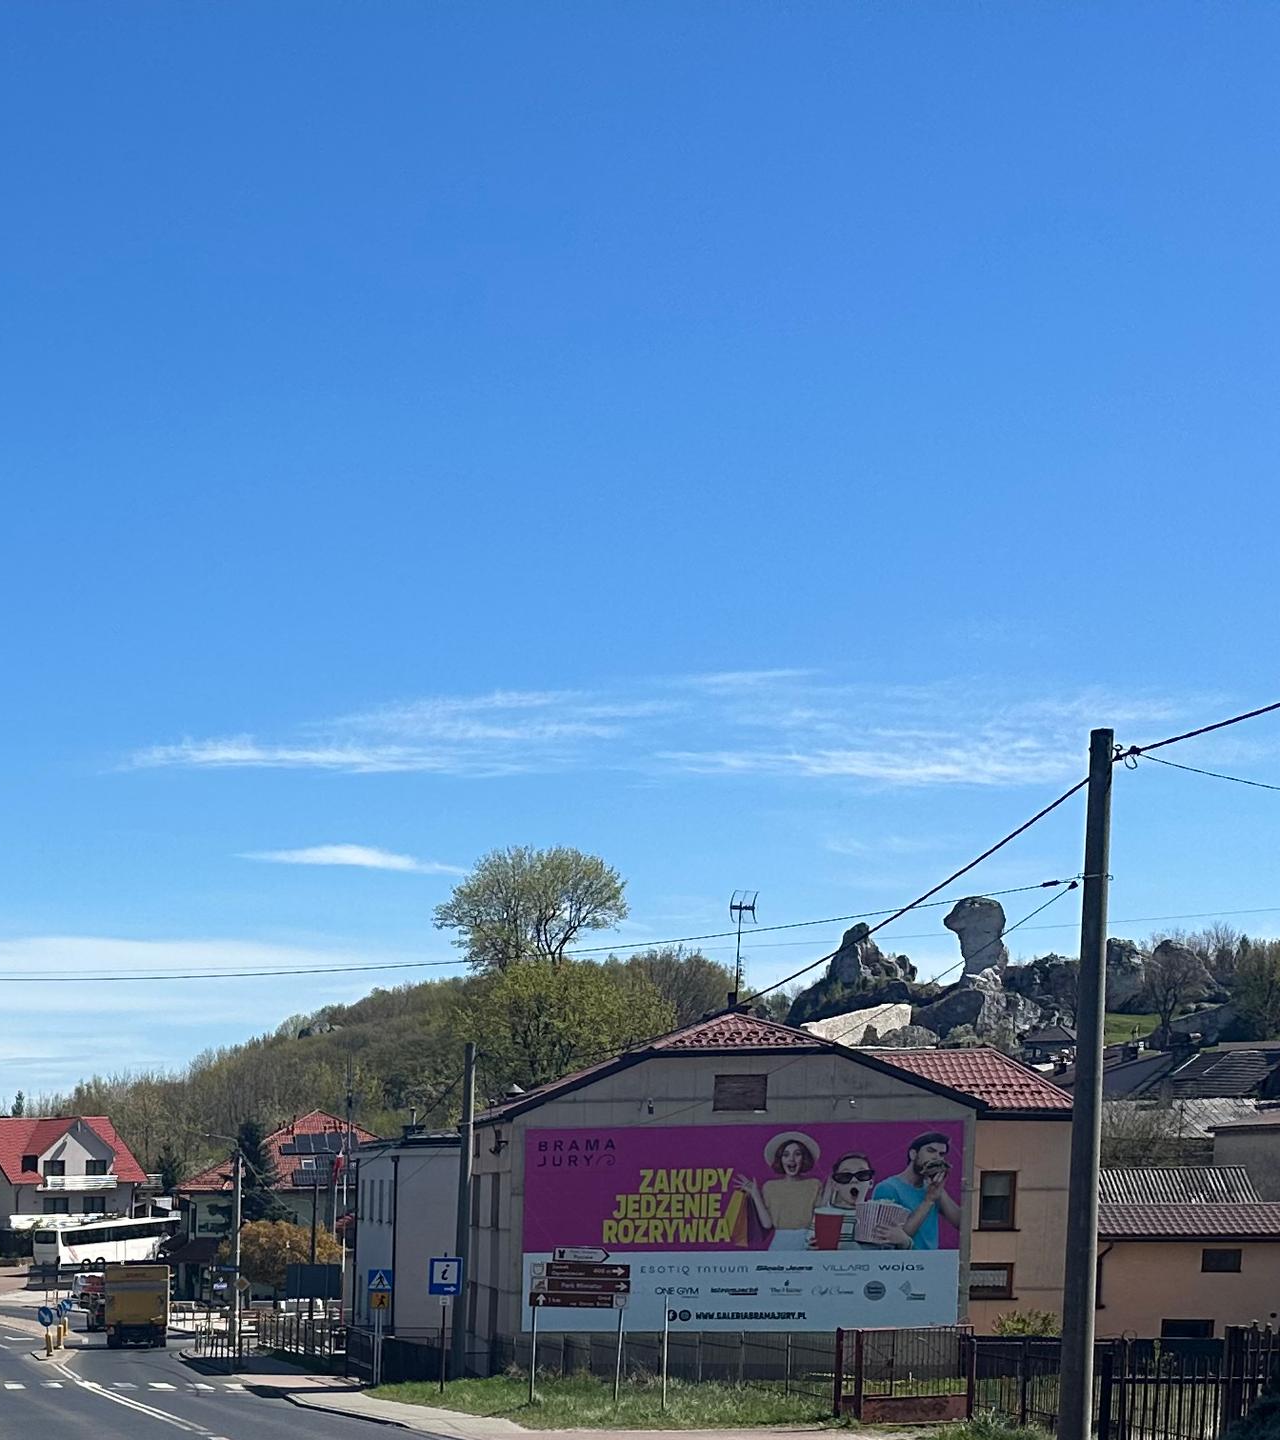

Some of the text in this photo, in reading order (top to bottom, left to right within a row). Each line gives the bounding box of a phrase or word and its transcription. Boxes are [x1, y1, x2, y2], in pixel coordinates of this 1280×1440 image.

[537, 1138, 616, 1152] BRAMA
[537, 1154, 594, 1167] JURY
[639, 1168, 734, 1193] ZAKUPY
[612, 1193, 722, 1219] JEDZENIE
[602, 1218, 732, 1243] ROZRYWKA
[640, 1265, 690, 1276] ESOTIQ
[878, 1262, 925, 1272] wojas
[655, 1287, 675, 1295] ONE
[676, 1287, 699, 1295] GYM
